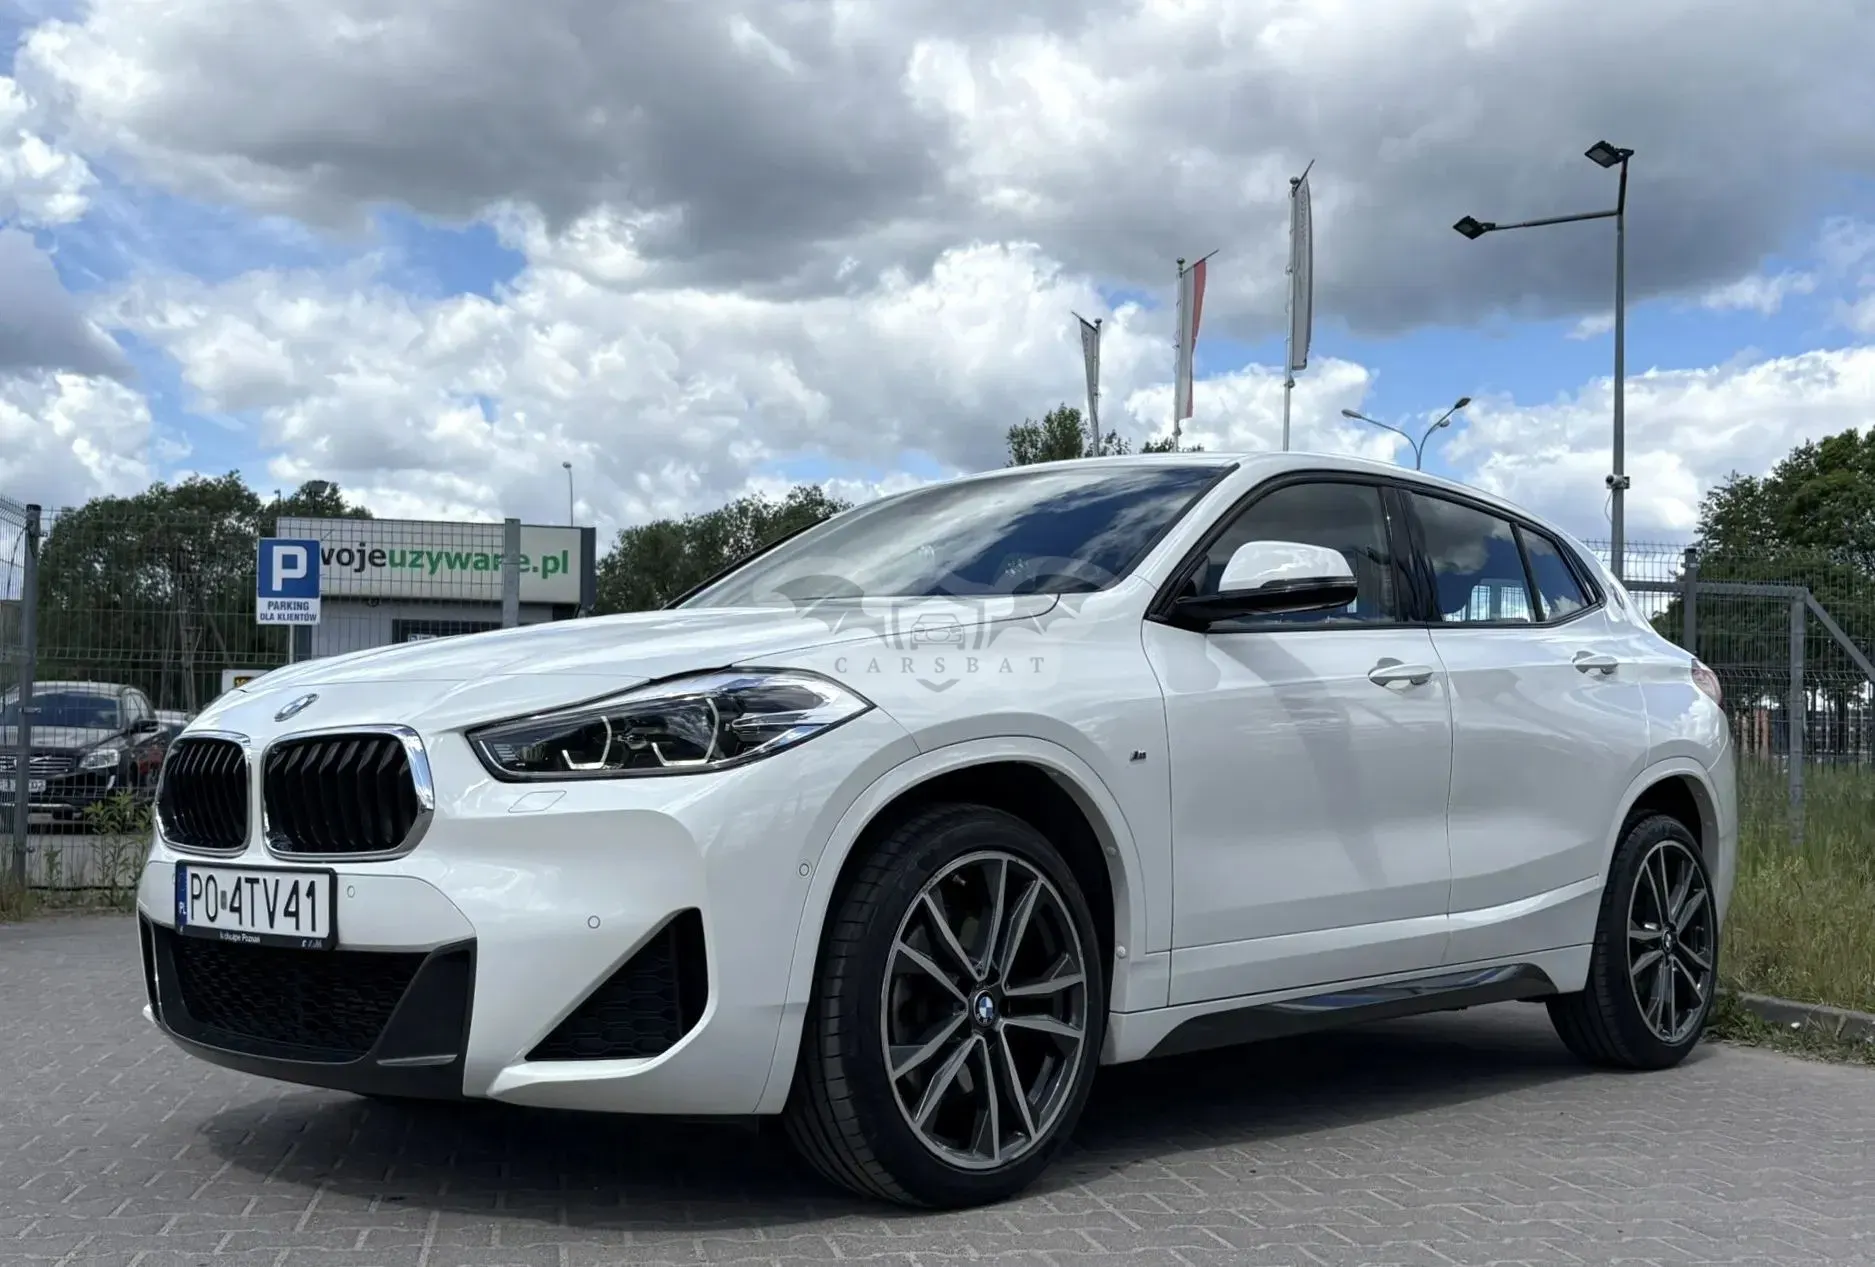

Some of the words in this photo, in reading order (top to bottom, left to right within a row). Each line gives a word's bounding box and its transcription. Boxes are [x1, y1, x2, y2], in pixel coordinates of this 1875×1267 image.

[272, 546, 307, 591] P
[260, 612, 275, 621] DLA
[277, 611, 317, 621] KLIENTÓW
[267, 600, 310, 611] PARKING
[190, 873, 218, 922] PO
[229, 876, 316, 932] 4TV41
